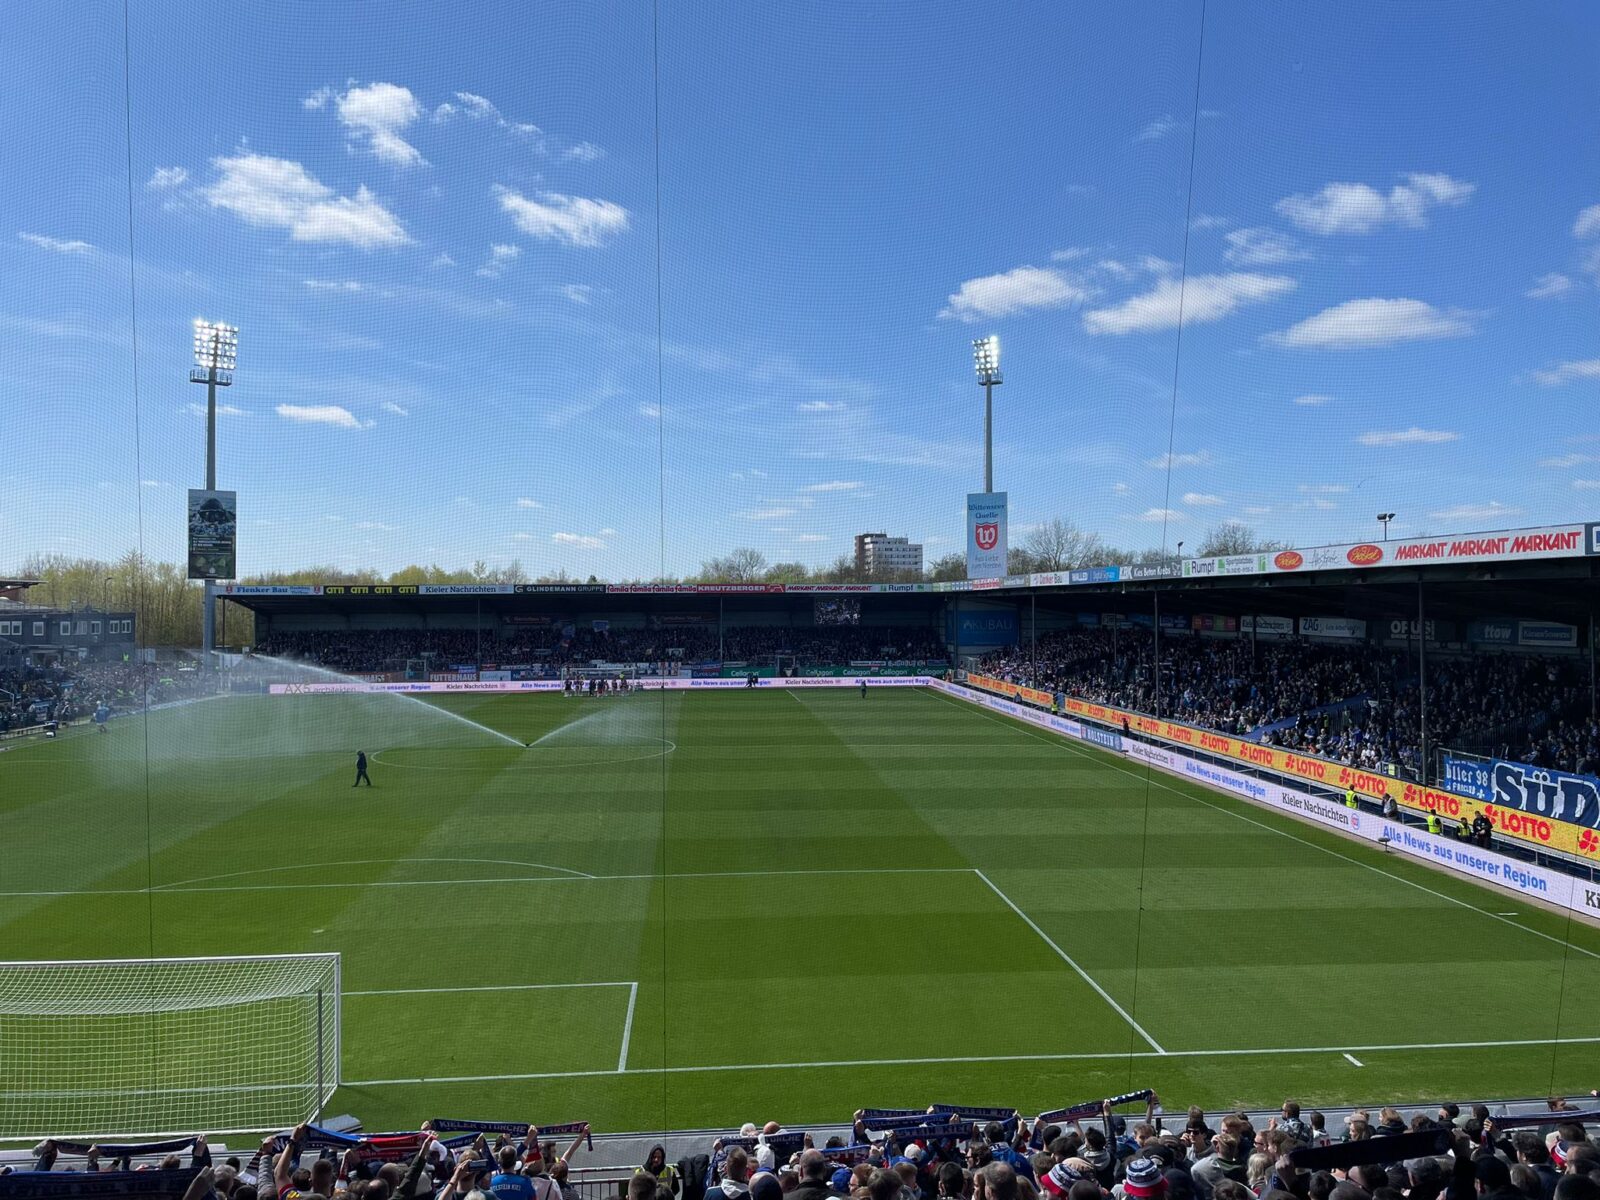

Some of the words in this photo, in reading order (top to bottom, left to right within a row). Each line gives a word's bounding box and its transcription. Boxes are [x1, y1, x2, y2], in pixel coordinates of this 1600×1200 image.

[1395, 542, 1448, 560] MARKANT
[1448, 538, 1509, 557] MARKANT
[1510, 532, 1582, 553] MARKANT
[1192, 560, 1215, 574] Rumpf
[1303, 618, 1318, 631] ZAG
[430, 673, 476, 681] FUTTERHAUS
[1143, 720, 1160, 733] LOTTO
[1174, 727, 1191, 742] LOTTO
[1087, 728, 1114, 747] HOLSTEIN
[1208, 738, 1230, 752] LOTTO
[1144, 747, 1169, 764] Nachrichten
[1249, 748, 1272, 765] LOTTO
[1296, 758, 1325, 778] LOTTO
[1186, 761, 1196, 773] Alle
[1196, 764, 1210, 778] News
[1212, 772, 1221, 782] aus
[1222, 776, 1244, 788] unserer
[1245, 780, 1266, 796] Region
[1352, 772, 1386, 794] LOTTO
[1476, 770, 1488, 787] 98
[1419, 790, 1460, 816] LOTTO
[1492, 762, 1600, 828] SÜD
[1282, 792, 1302, 810] Kieler
[1304, 798, 1349, 825] Nachrichten
[1502, 810, 1550, 841] LOTTO
[1383, 825, 1402, 844] Alle
[1404, 832, 1432, 852] News
[1434, 844, 1453, 860] aus
[1455, 849, 1500, 876] unserer
[1503, 863, 1547, 892] Region
